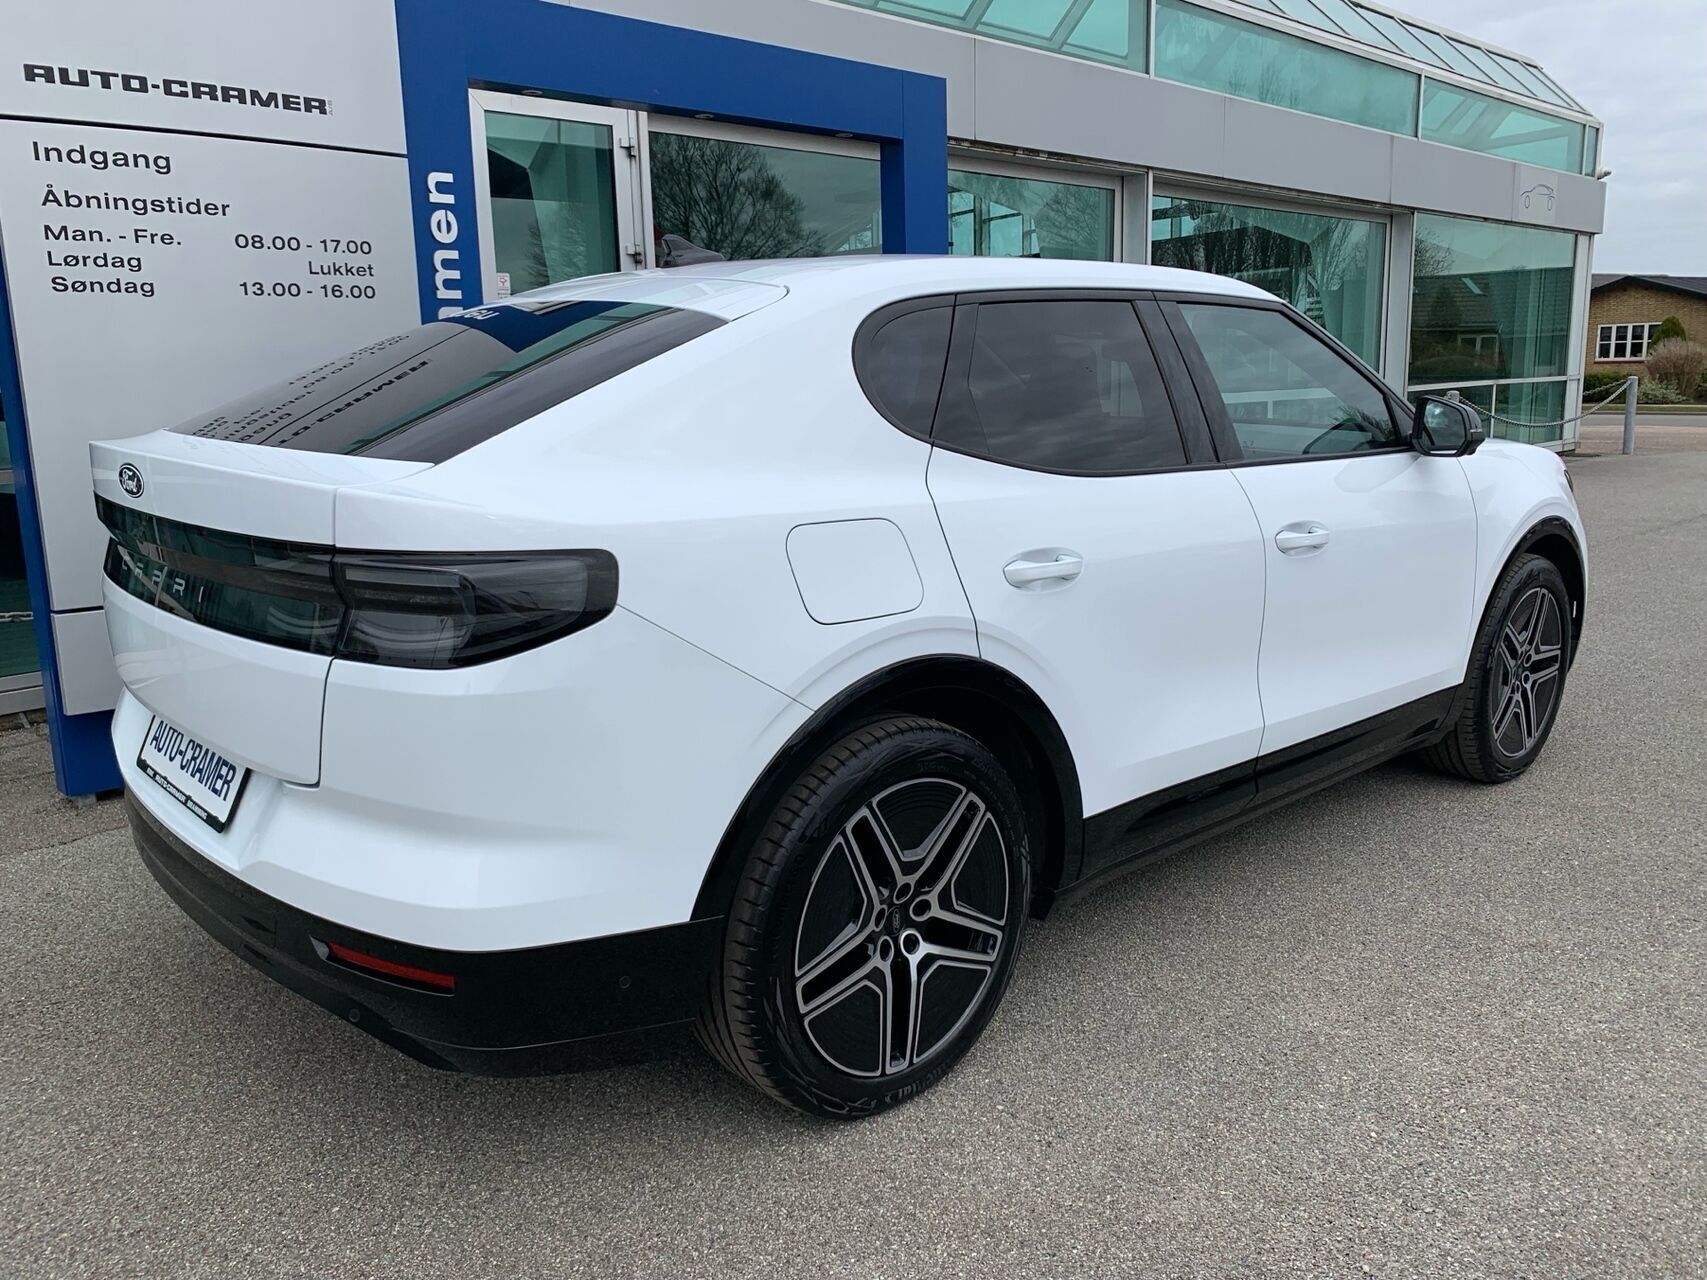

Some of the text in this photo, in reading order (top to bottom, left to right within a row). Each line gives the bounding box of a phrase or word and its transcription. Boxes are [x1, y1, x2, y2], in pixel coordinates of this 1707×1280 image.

[23, 63, 327, 116] AUTO-CRAMER
[31, 141, 171, 174] Indgang
[41, 184, 230, 217] Åbningstider
[43, 225, 112, 243] Man.
[133, 229, 182, 246] Fre.
[234, 233, 301, 251] 08.00
[319, 239, 372, 255] 17.00
[47, 251, 375, 277] Lørdag Lukket
[51, 277, 155, 298] Søndag
[239, 281, 301, 298] 13.00
[320, 284, 376, 300] 16.00
[119, 467, 141, 494] Ford
[150, 720, 236, 801] AUTO-CRAMER
